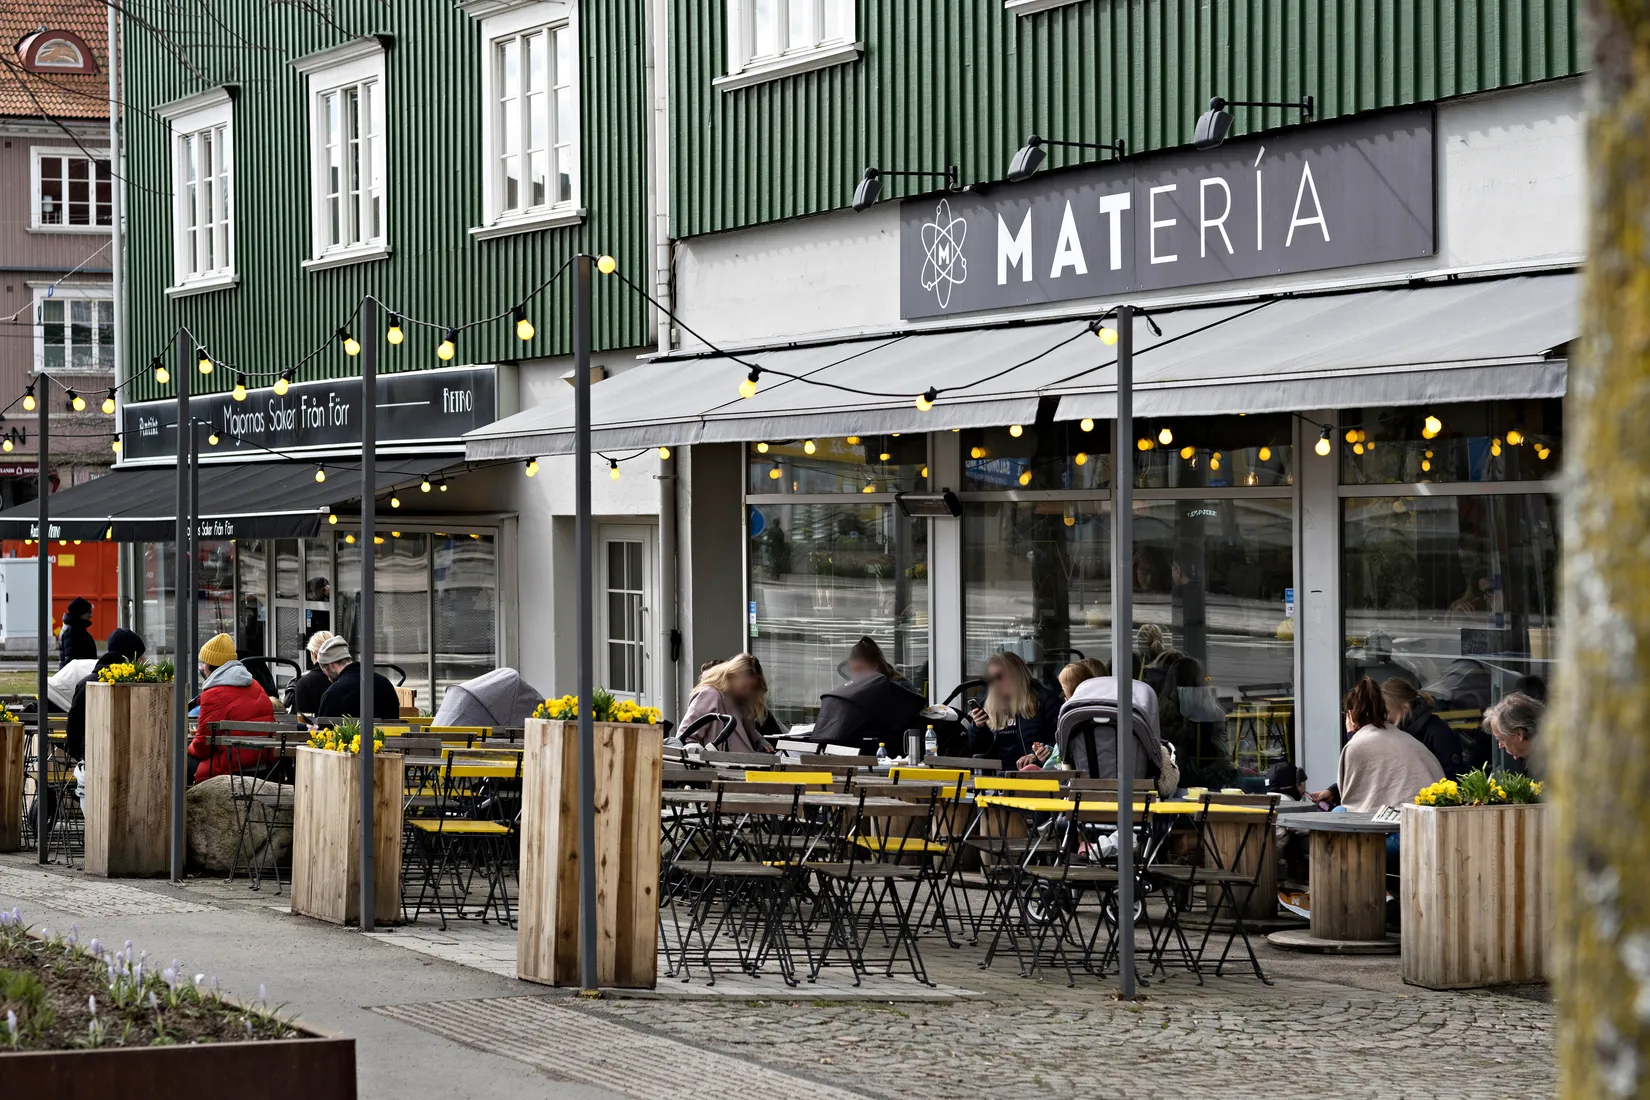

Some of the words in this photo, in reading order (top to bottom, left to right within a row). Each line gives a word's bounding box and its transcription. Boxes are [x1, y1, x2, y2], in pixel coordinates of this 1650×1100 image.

[997, 146, 1331, 286] MATERÍA
[223, 404, 265, 446] Majornas
[268, 398, 296, 431] Saker
[301, 395, 325, 428] Från
[328, 392, 350, 426] Förr
